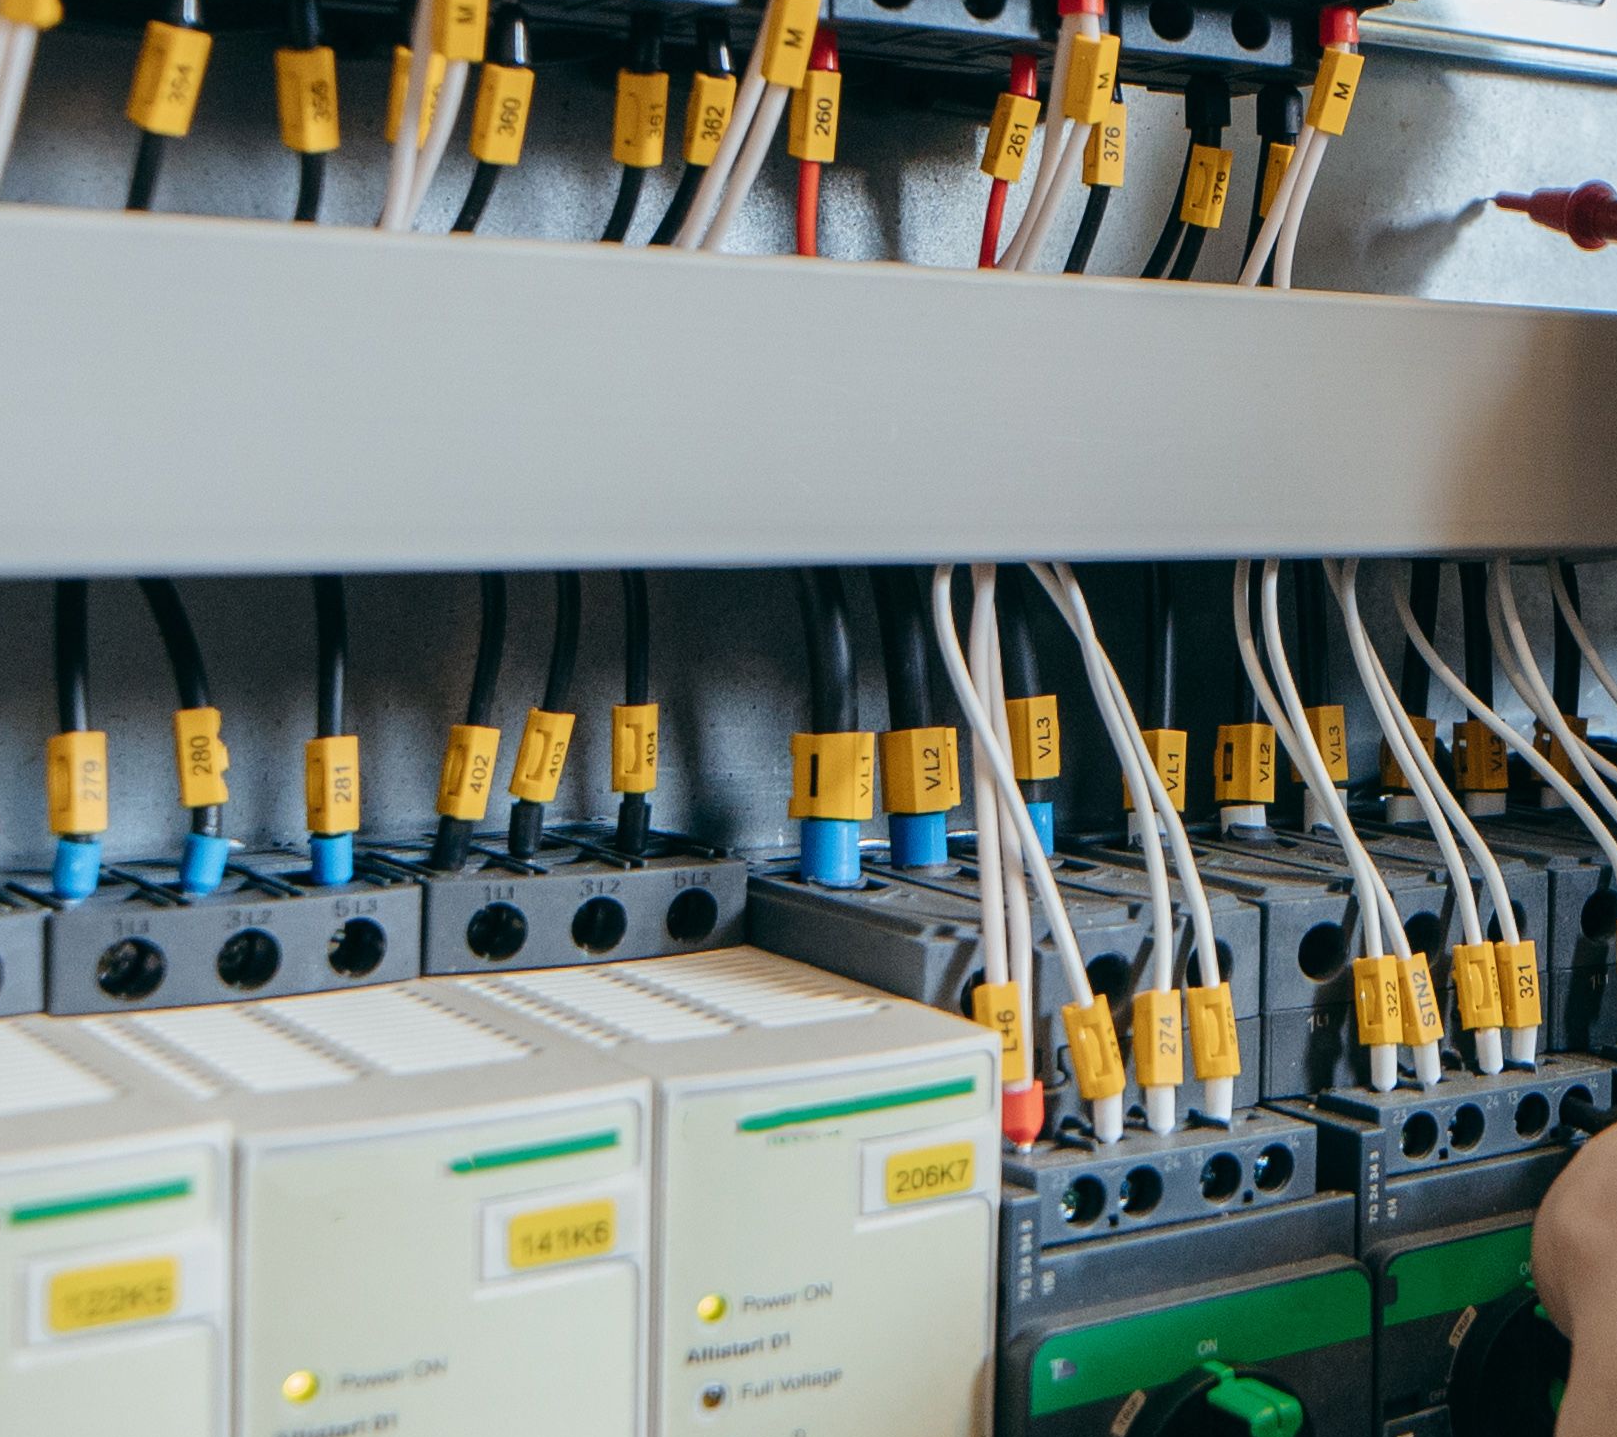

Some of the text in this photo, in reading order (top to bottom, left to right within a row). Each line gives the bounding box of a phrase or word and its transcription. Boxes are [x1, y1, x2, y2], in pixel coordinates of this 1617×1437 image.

[456, 2, 478, 25] M
[784, 28, 806, 50] M
[1096, 71, 1111, 92] M
[1333, 80, 1352, 101] M
[496, 97, 523, 140] 360
[647, 101, 664, 140] 361
[700, 105, 727, 142] 362
[814, 97, 834, 137] 260
[1006, 121, 1030, 160] 261
[1103, 125, 1121, 163] 376
[1210, 170, 1227, 206] 376
[189, 734, 214, 778] 280
[644, 731, 658, 769] 404
[1037, 714, 1053, 761] V.L3
[1329, 724, 1343, 767] V.L3
[469, 753, 491, 796] 402
[548, 740, 567, 780] 403
[859, 754, 872, 799] V.L1
[924, 744, 942, 793] V.L2
[1165, 750, 1181, 794] V.L1
[1258, 741, 1273, 784] V.L2
[83, 759, 104, 803] 279
[334, 764, 353, 805] 281
[1386, 979, 1399, 1018] 322
[1414, 968, 1437, 1028] STN2
[1518, 963, 1535, 999] 321
[997, 1008, 1019, 1054] L+6
[1159, 1014, 1177, 1056] 274
[895, 1159, 970, 1196] 206K7
[518, 1220, 609, 1255] 141K6
[741, 1282, 834, 1312] Power ON
[1196, 1338, 1219, 1356] ON
[741, 1366, 843, 1401] Full Voltage
